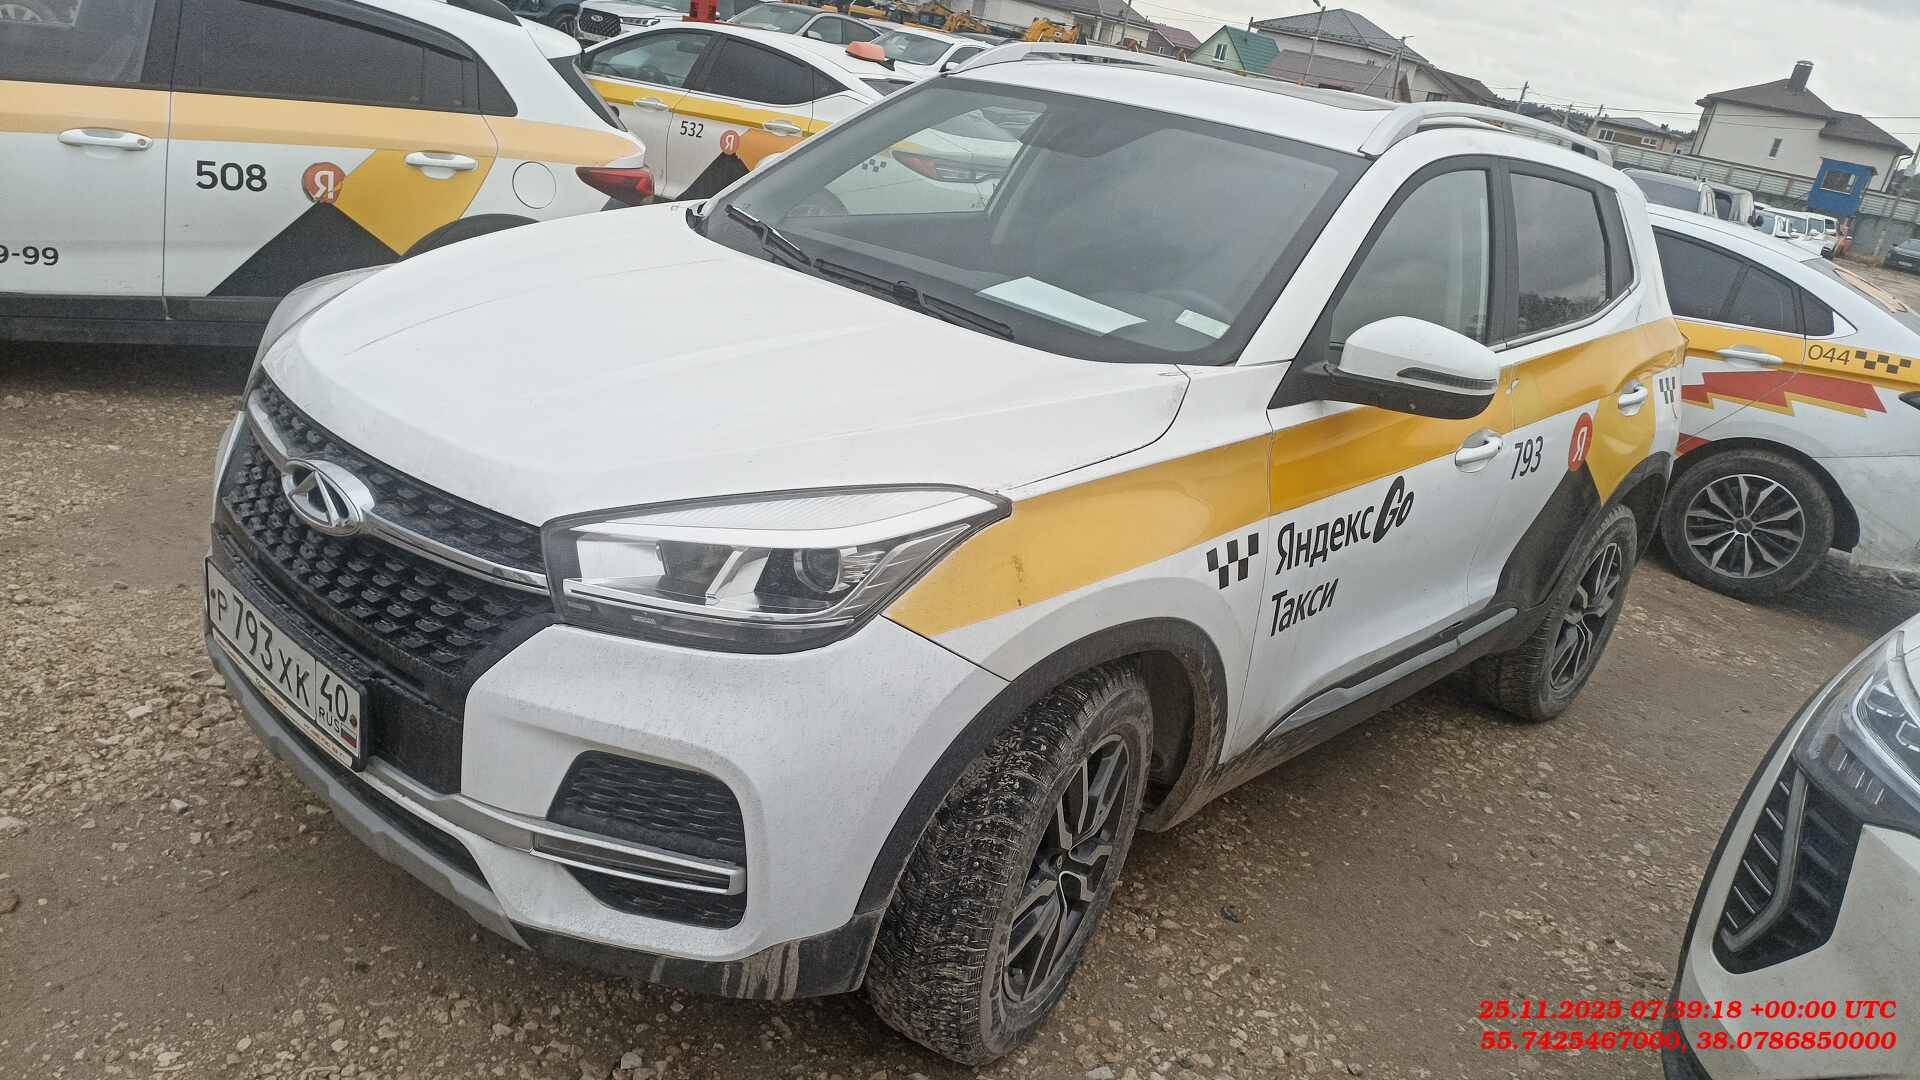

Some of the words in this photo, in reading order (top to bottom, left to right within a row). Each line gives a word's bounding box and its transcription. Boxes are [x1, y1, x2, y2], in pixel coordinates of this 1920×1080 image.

[680, 120, 704, 138] 532
[196, 160, 267, 192] 508
[1808, 344, 1850, 366] 044
[1510, 435, 1544, 480] 793
[1269, 578, 1339, 637] Такси
[320, 673, 349, 723] 40
[319, 706, 341, 733] RUS
